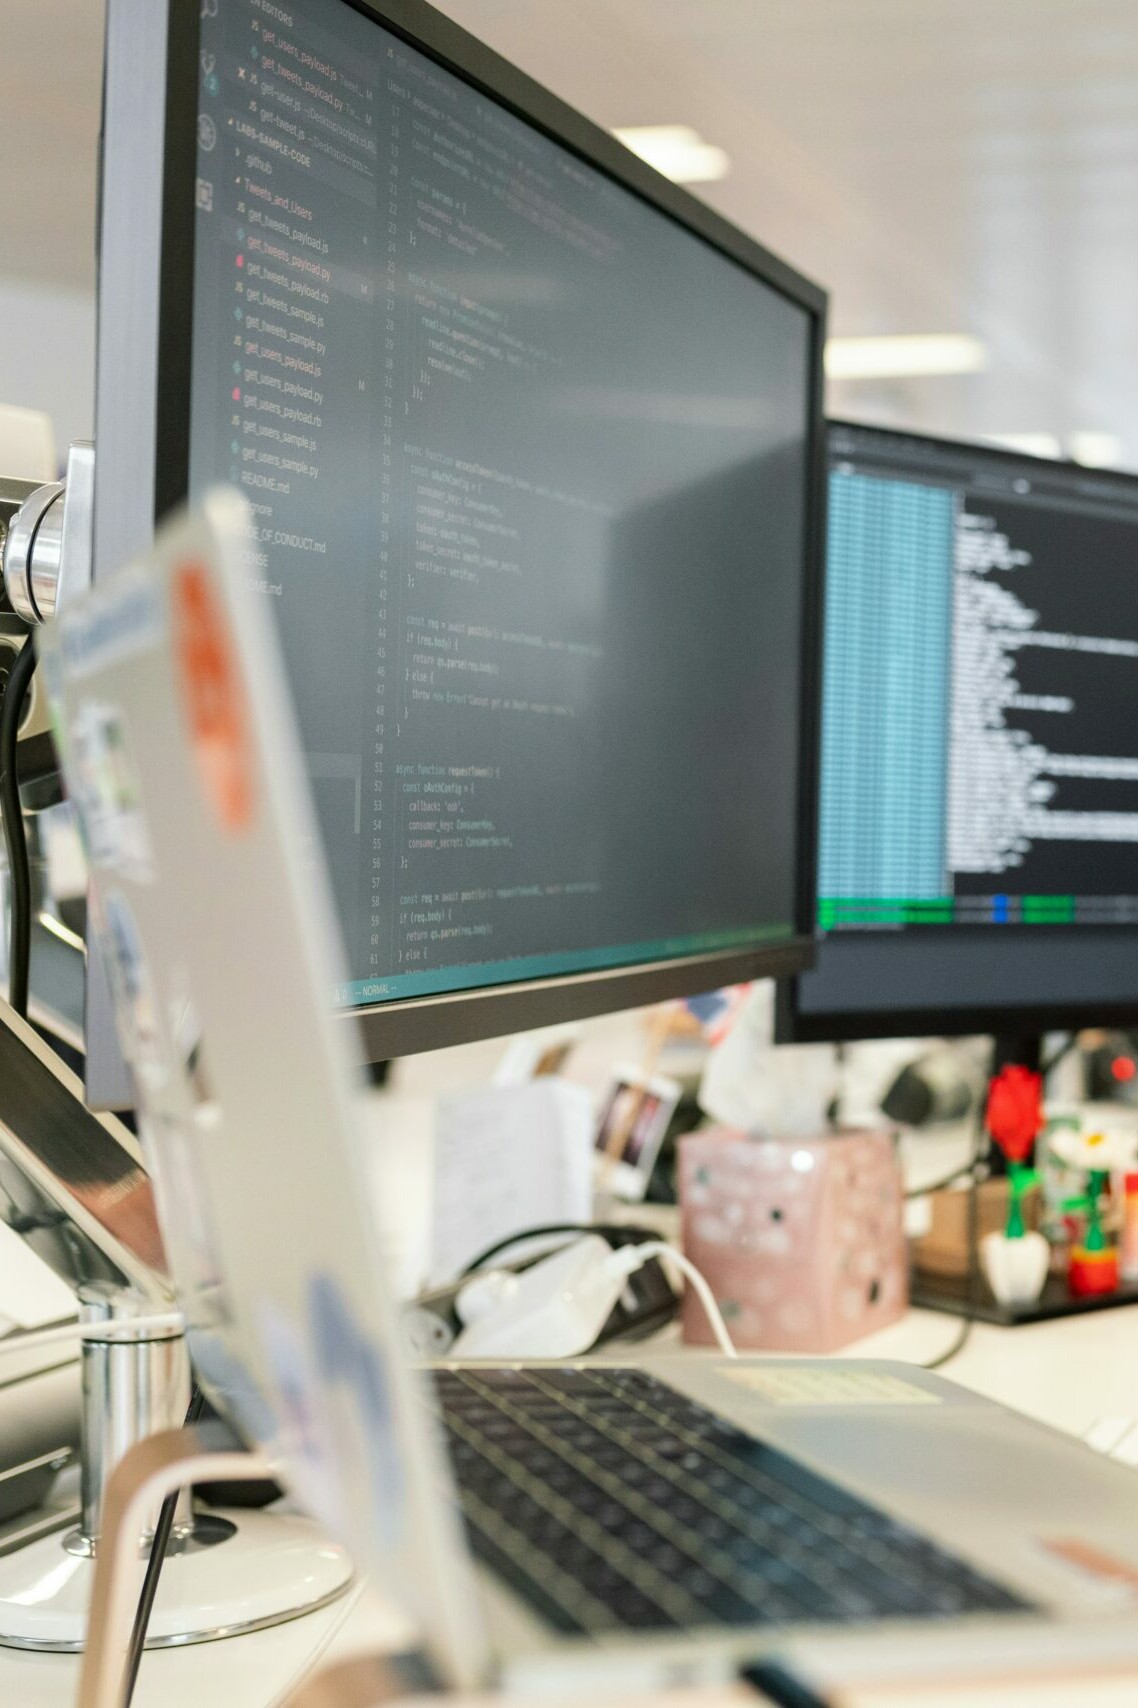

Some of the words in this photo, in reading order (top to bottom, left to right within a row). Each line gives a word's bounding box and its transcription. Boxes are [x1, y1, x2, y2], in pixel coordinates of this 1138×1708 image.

[262, 29, 337, 81] get_users_payload.js
[262, 56, 343, 112] get_tweets_payload.py
[236, 120, 311, 167] LABS-SAMPLE-CODE
[245, 178, 312, 221] Tweets_and_Users
[248, 209, 329, 254] get_tweets_payload.js
[247, 236, 331, 282] get_tweets_payload.py
[247, 263, 329, 304] get_tweets_payload.rb
[246, 289, 324, 328] get_tweets_sample.js
[245, 315, 326, 356] get_tweets_sample.py
[245, 342, 321, 378] get_users_payload.js
[244, 368, 323, 405] get_users_payload.py
[384, 376, 392, 388] 31
[243, 395, 322, 427] get_users_payload.rb
[242, 420, 317, 452] get_users_sample.js
[241, 447, 319, 479] get_users_sample.py
[382, 453, 390, 466] 35
[241, 471, 290, 494] README.md
[382, 473, 390, 485] 36
[382, 492, 389, 504] 37
[381, 512, 389, 523] 38
[380, 531, 388, 543] 39
[380, 551, 388, 562] 40
[379, 570, 387, 581] 41
[379, 588, 387, 600] 42
[378, 608, 386, 620] 43
[377, 627, 386, 639] 44
[377, 647, 386, 659] 45
[377, 666, 385, 678] 46
[376, 684, 385, 696] 47
[376, 704, 384, 716] 48
[375, 723, 384, 735] 49
[396, 723, 401, 737] }
[374, 743, 383, 754] 50
[374, 761, 383, 773] 51
[395, 764, 413, 777] async
[417, 763, 446, 775] function
[374, 780, 382, 792] 52
[402, 783, 421, 793] const
[373, 801, 382, 811] 53
[409, 802, 441, 812] callback:
[373, 820, 382, 831] 54
[408, 820, 454, 833] consumer_key:
[372, 838, 381, 849] 55
[408, 838, 463, 850] consumer_secret:
[372, 858, 381, 869] 56
[400, 855, 408, 870] };
[372, 878, 380, 889] 57
[371, 896, 380, 907] 58
[400, 895, 418, 906] const
[421, 894, 433, 907] req
[371, 915, 380, 927] 59
[399, 914, 408, 925] if
[370, 934, 379, 946] 60
[406, 931, 428, 942] return
[370, 954, 378, 965] 61
[398, 950, 403, 962] }
[405, 950, 421, 960] else
[363, 984, 390, 996] NORMAL
